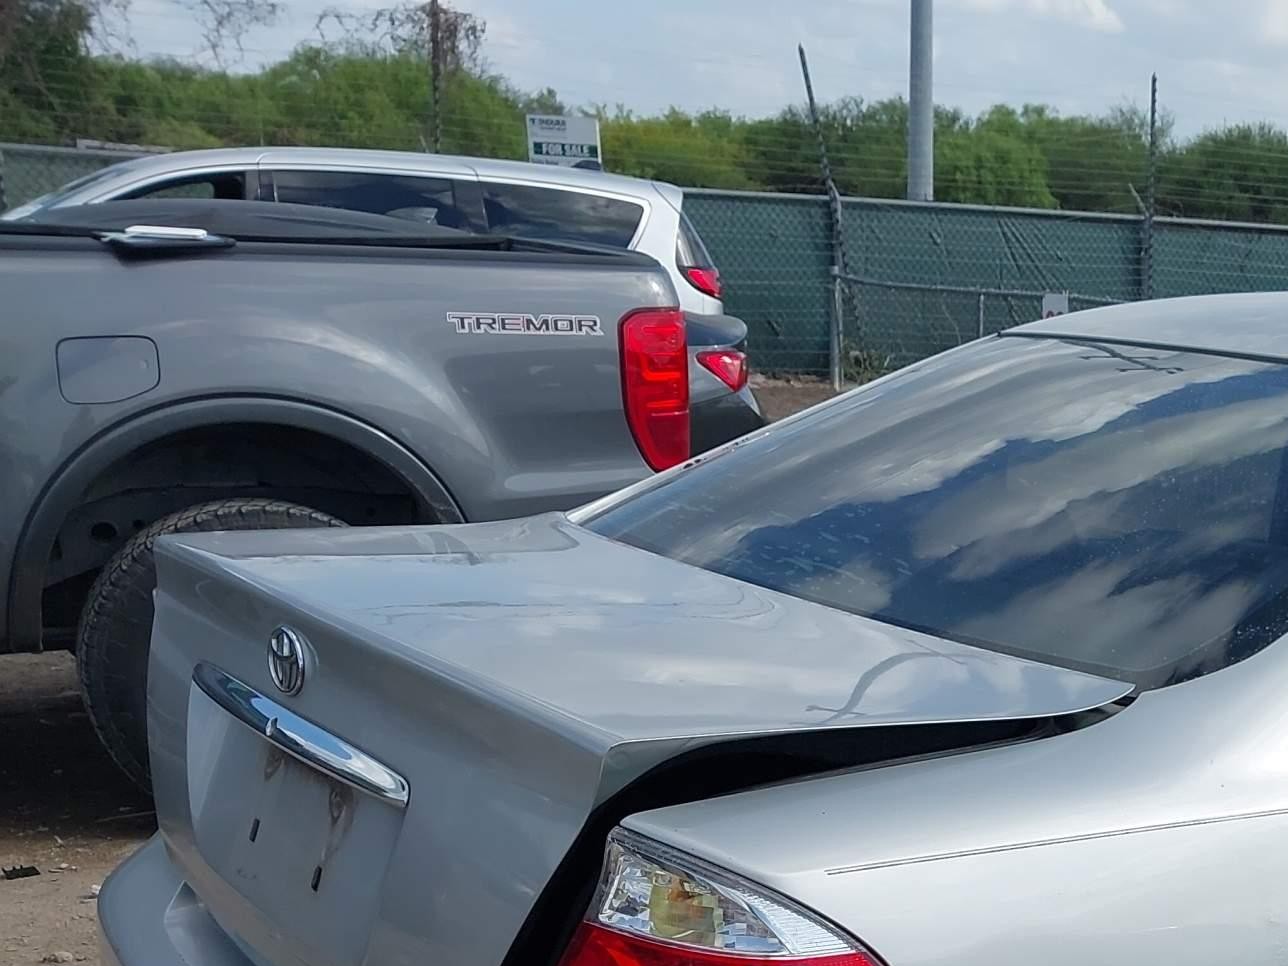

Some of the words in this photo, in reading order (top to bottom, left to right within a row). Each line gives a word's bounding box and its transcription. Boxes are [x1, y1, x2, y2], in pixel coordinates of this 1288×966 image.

[542, 143, 562, 155] FOR
[564, 144, 590, 157] SALE
[447, 312, 604, 336] TREMOR
